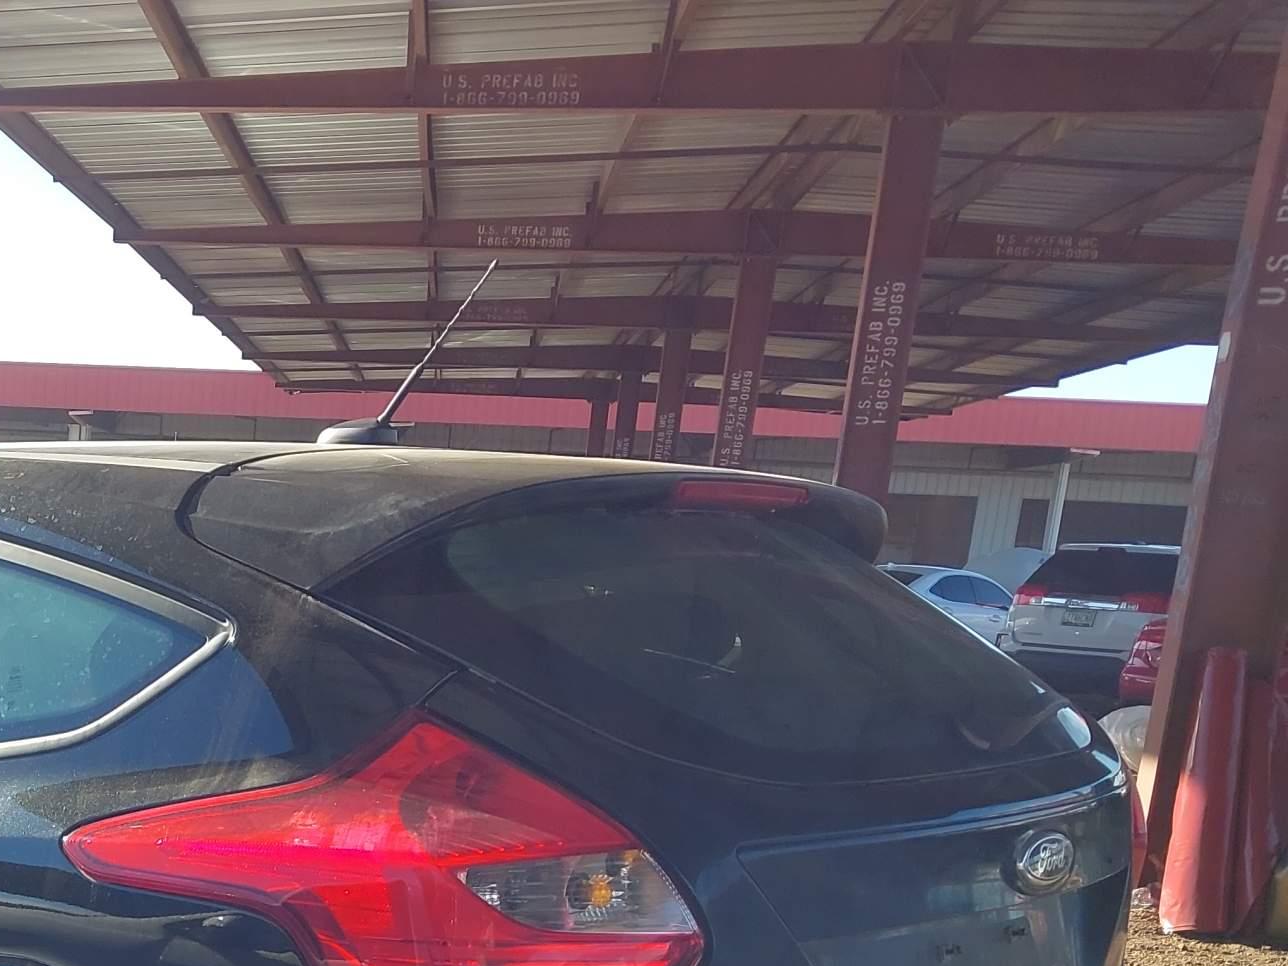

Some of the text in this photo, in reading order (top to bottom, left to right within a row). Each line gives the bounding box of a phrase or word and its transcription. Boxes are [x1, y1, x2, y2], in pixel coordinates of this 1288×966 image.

[481, 74, 544, 89] PREFAB
[504, 225, 546, 237] PREFAB
[855, 281, 890, 425] U.S. PREFAB INC.
[872, 282, 906, 424] 1-866-799-0969
[723, 396, 738, 439] PREFAB
[1038, 842, 1065, 873] Ford
